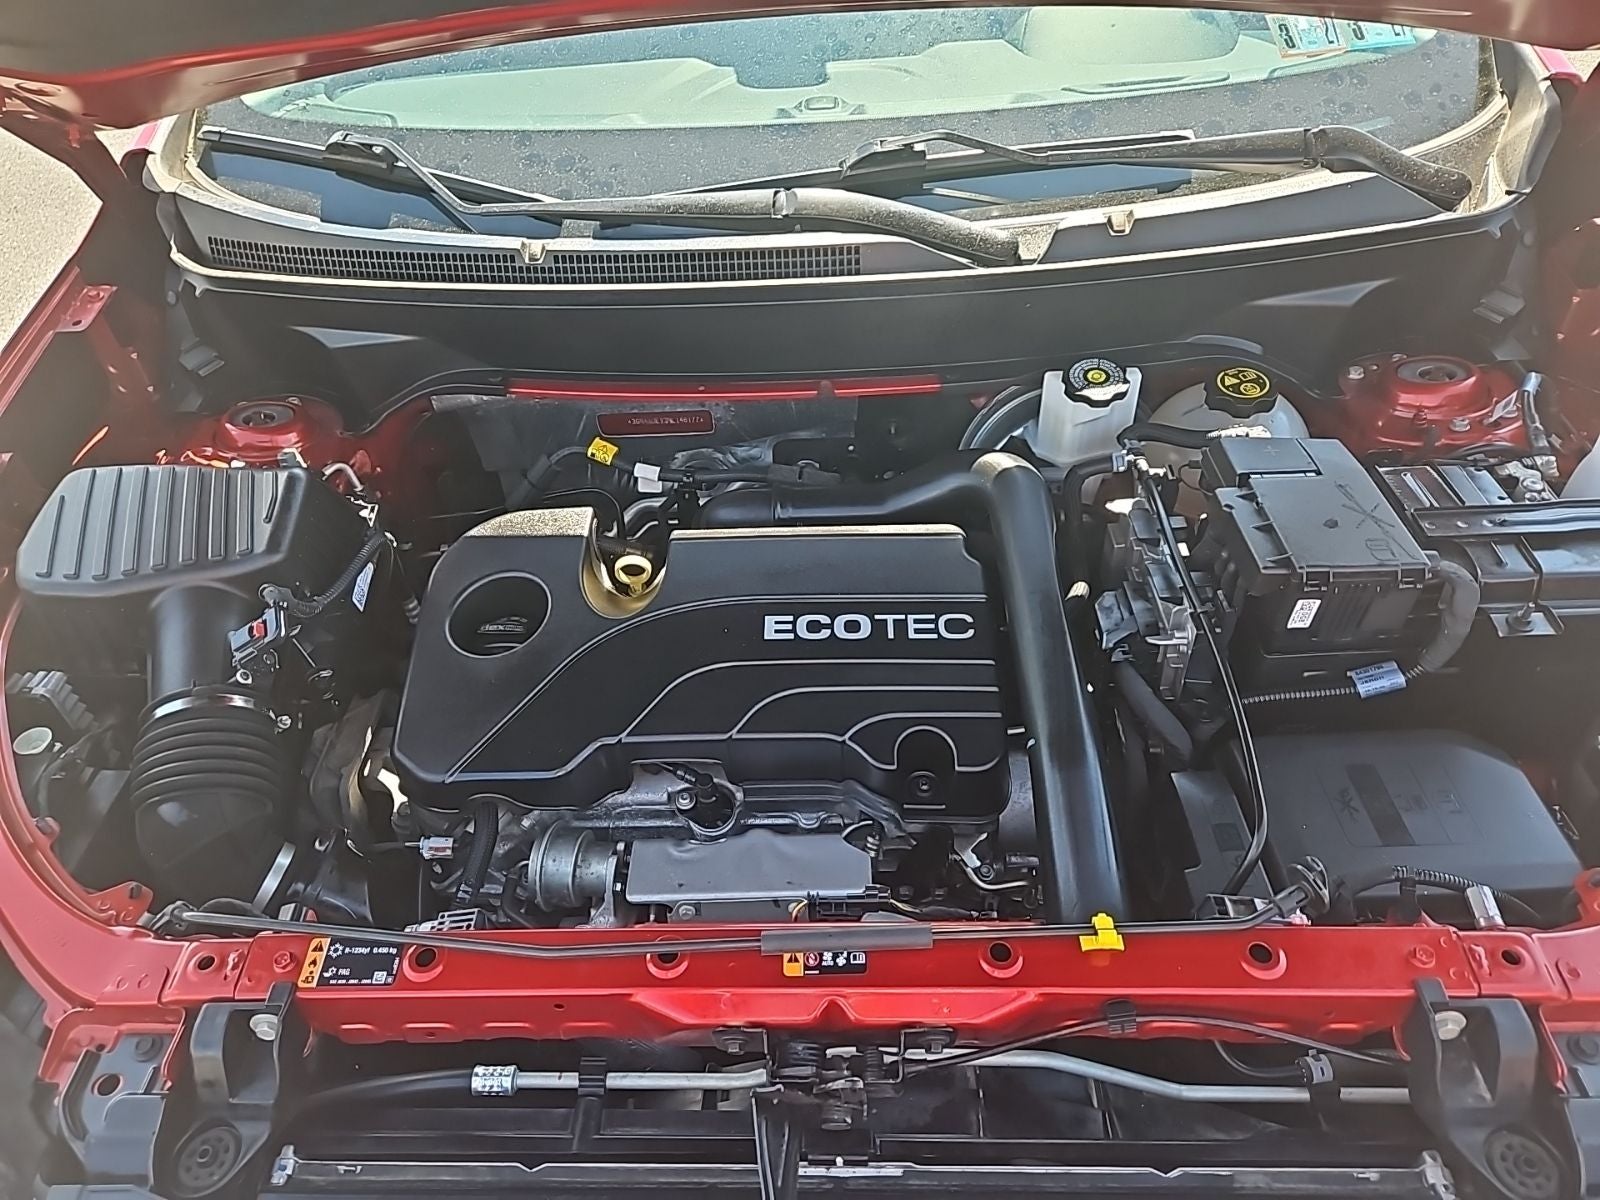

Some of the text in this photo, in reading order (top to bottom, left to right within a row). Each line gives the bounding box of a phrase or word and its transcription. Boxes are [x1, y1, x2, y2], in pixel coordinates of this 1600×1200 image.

[1278, 23, 1297, 49] 3
[763, 613, 975, 640] ECOTEC
[389, 946, 398, 955] kg
